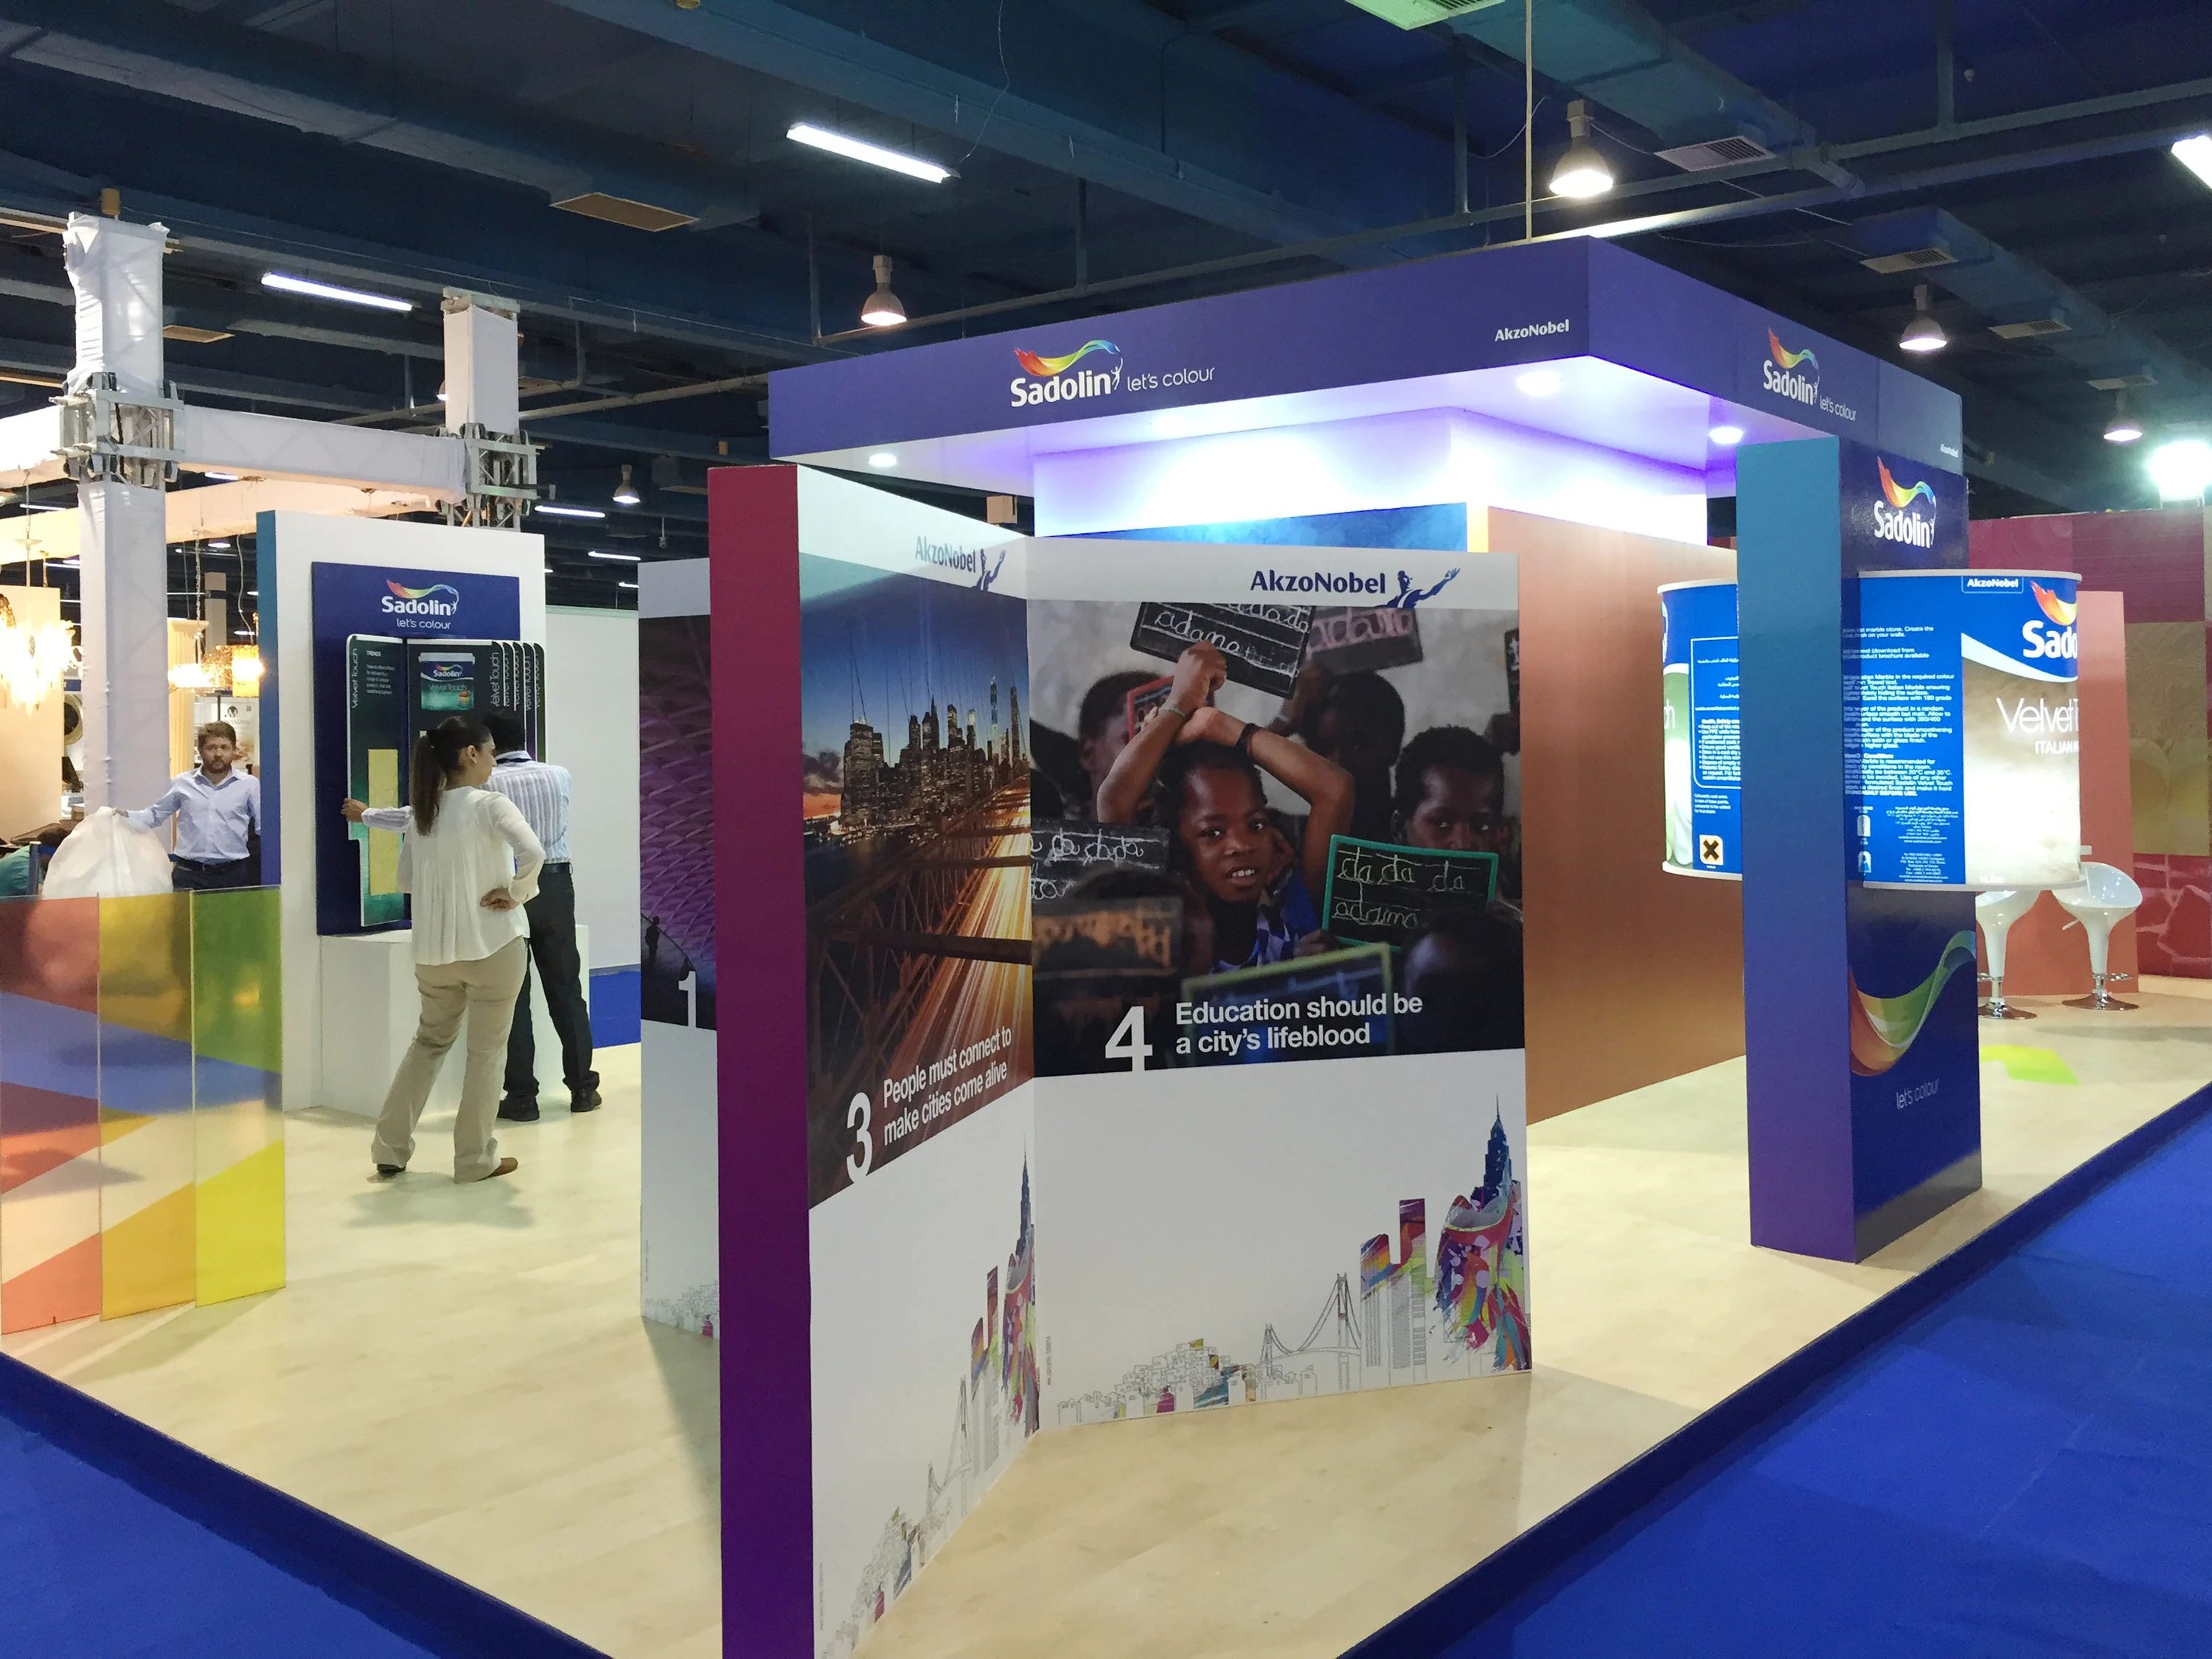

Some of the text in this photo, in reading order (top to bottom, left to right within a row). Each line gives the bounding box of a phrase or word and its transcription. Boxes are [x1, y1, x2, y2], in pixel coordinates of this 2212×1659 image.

[1495, 319, 1570, 342] AkzoNobel
[1010, 367, 1215, 407] Sadolin let's colour
[1763, 360, 1857, 421] Sadolin let's colour
[1874, 500, 1930, 549] Sadolin
[915, 535, 976, 573] AkzoNobel
[1250, 569, 1386, 594] AkzoNobel
[1967, 578, 2019, 588] AkzoNobel
[381, 596, 451, 616] Sadolin
[397, 618, 451, 629] let's colour
[433, 669, 461, 678] Sadolin
[490, 653, 500, 681] Touch
[1996, 698, 2073, 733] Velvet
[678, 970, 696, 1028] 1
[1175, 992, 1423, 1026] Education should be
[1105, 1006, 1153, 1072] 4
[1175, 1023, 1370, 1057] a city's lifeblood
[883, 1026, 1012, 1109] People must connect to
[884, 1061, 1007, 1146] make cities come alive
[846, 1092, 872, 1183] 3
